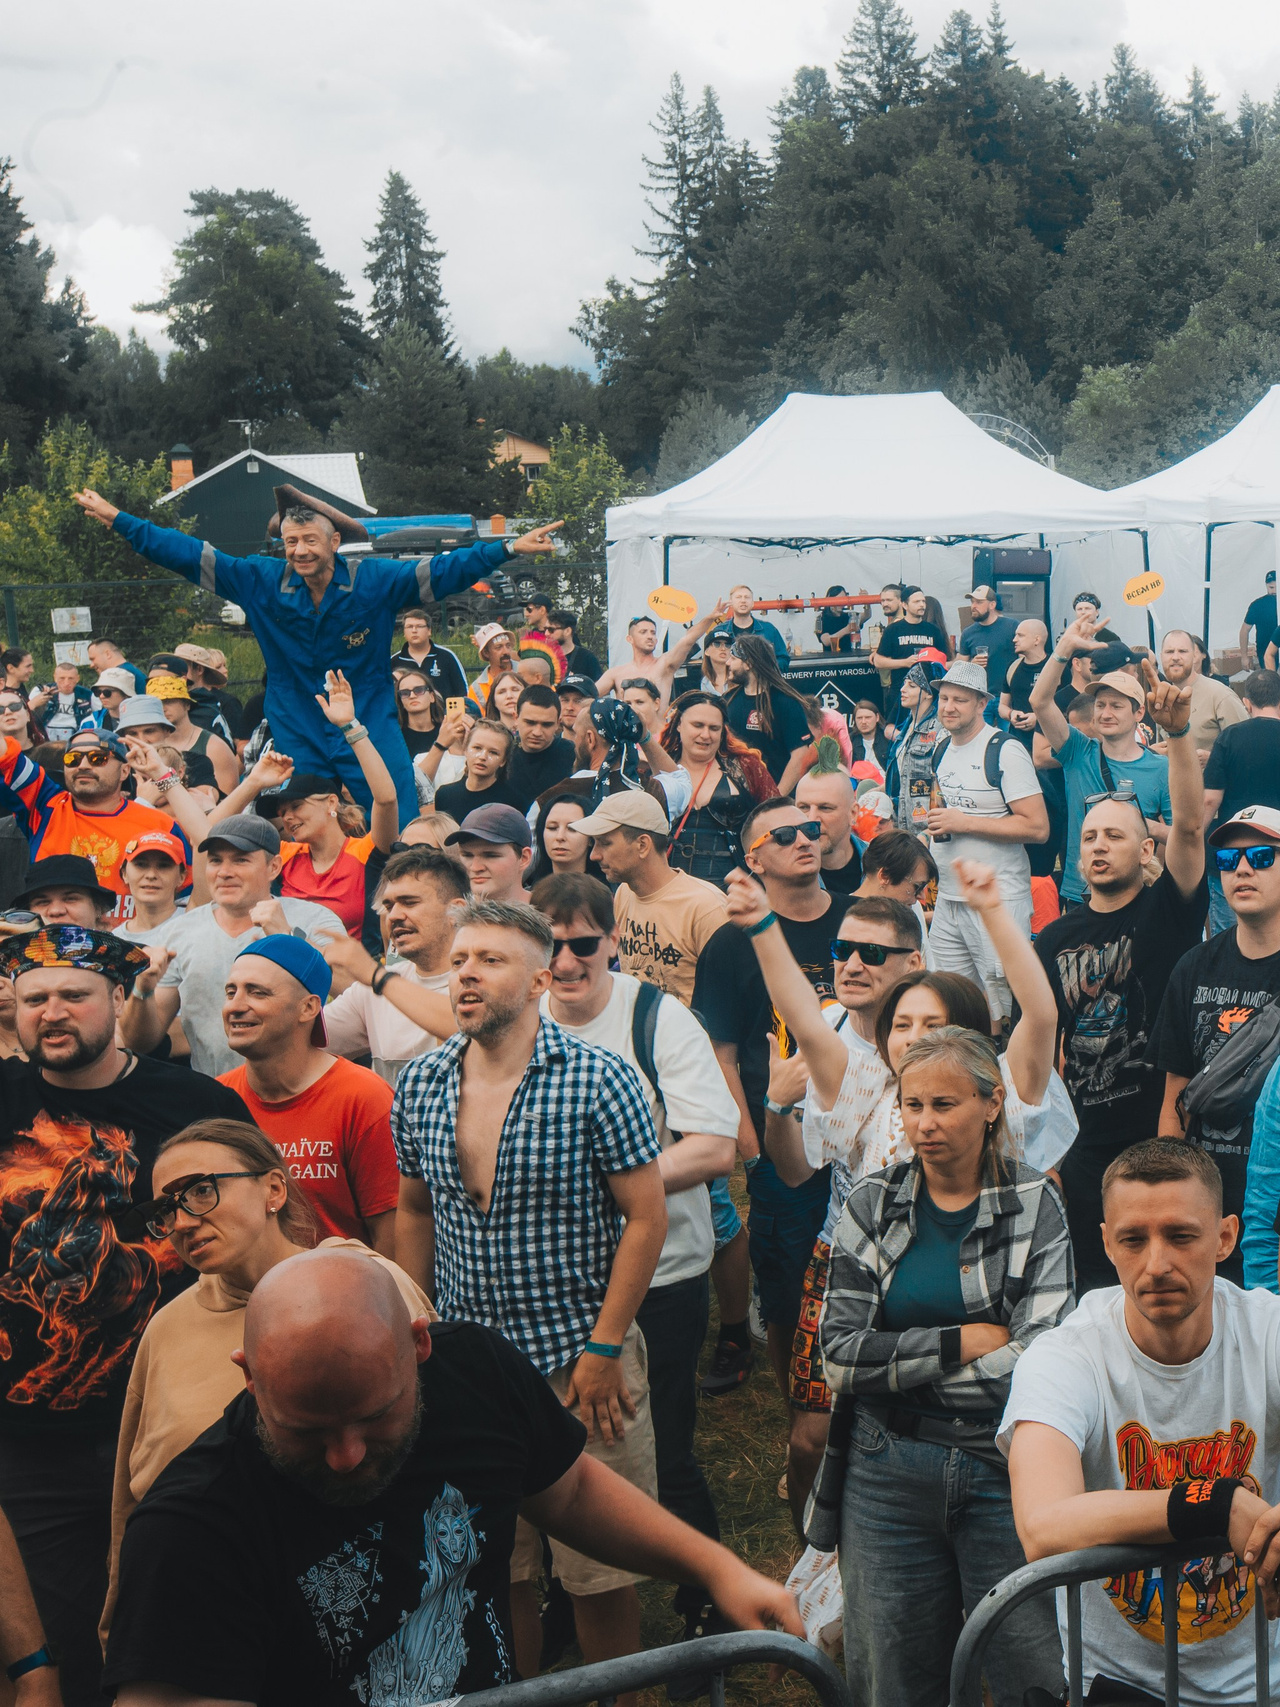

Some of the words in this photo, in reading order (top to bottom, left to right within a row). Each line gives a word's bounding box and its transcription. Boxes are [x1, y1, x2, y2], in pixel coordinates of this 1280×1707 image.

[781, 671, 814, 680] REWERY
[838, 667, 880, 676] YAROSLAV
[274, 1138, 334, 1158] NAÏVE
